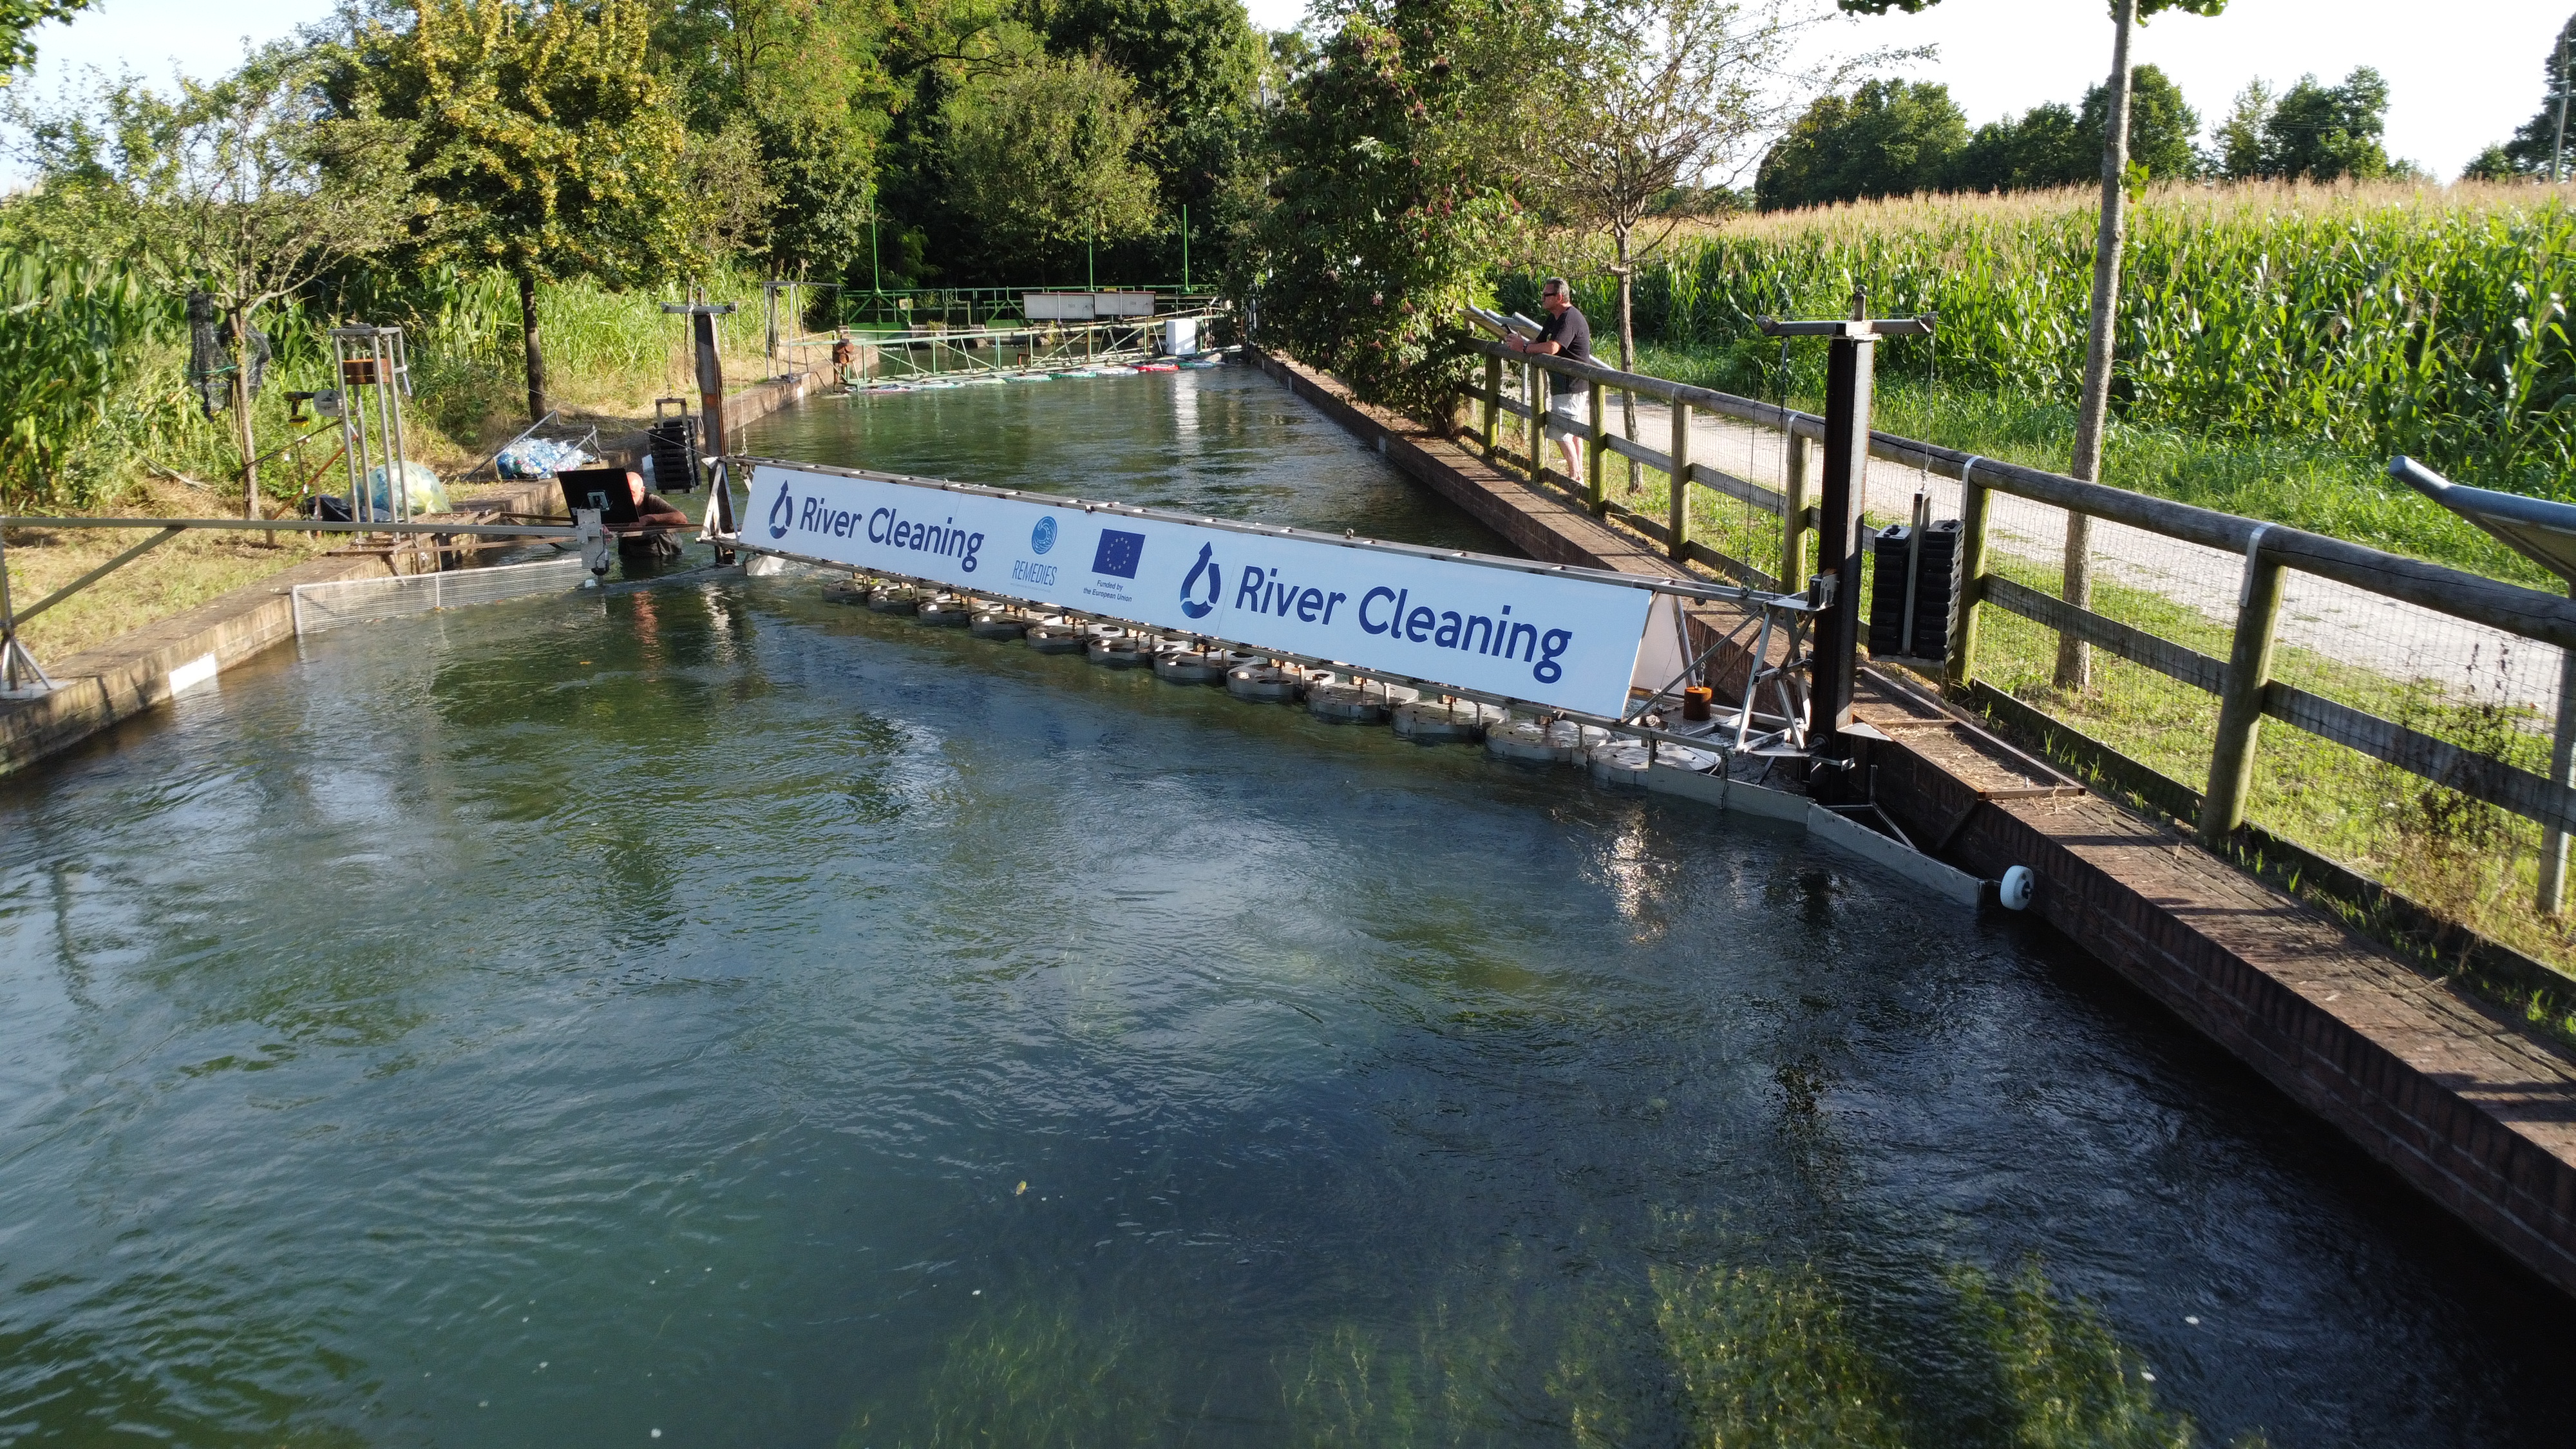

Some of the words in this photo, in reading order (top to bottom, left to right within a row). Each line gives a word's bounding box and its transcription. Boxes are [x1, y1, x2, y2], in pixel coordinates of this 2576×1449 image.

[799, 497, 863, 538] River
[868, 507, 985, 573] Cleaning
[1012, 560, 1057, 586] REMEDIES
[1097, 580, 1116, 589] Funded
[1116, 583, 1124, 592] by
[1092, 589, 1116, 599] European
[1117, 593, 1132, 602] Union
[1235, 565, 1347, 625] River
[1358, 586, 1573, 684] Cleaning
